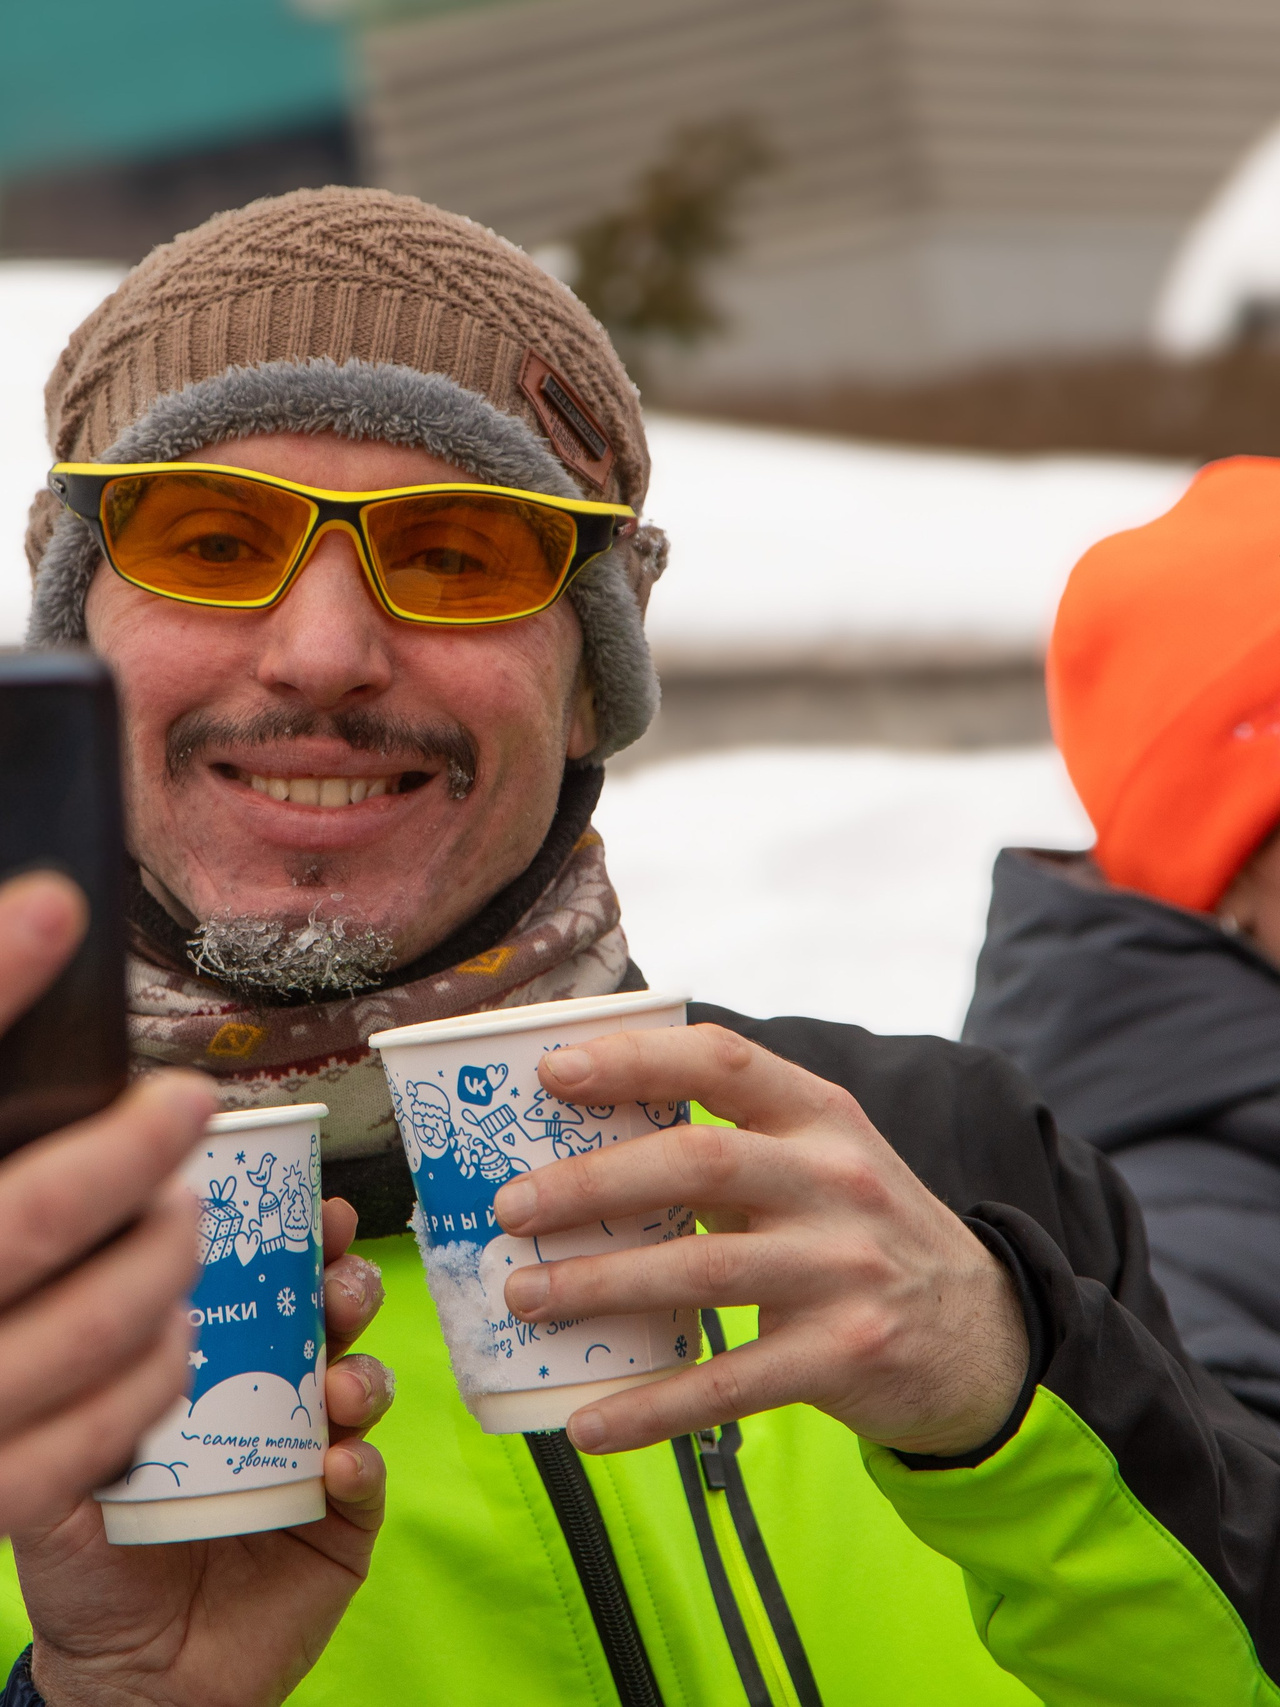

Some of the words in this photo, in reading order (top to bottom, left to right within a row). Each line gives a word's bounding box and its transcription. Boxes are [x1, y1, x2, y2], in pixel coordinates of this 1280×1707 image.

[463, 1075, 488, 1098] VK
[516, 1323, 541, 1347] VK
[202, 1433, 260, 1448] самые
[265, 1437, 315, 1450] теплые
[232, 1448, 287, 1475] звонки
